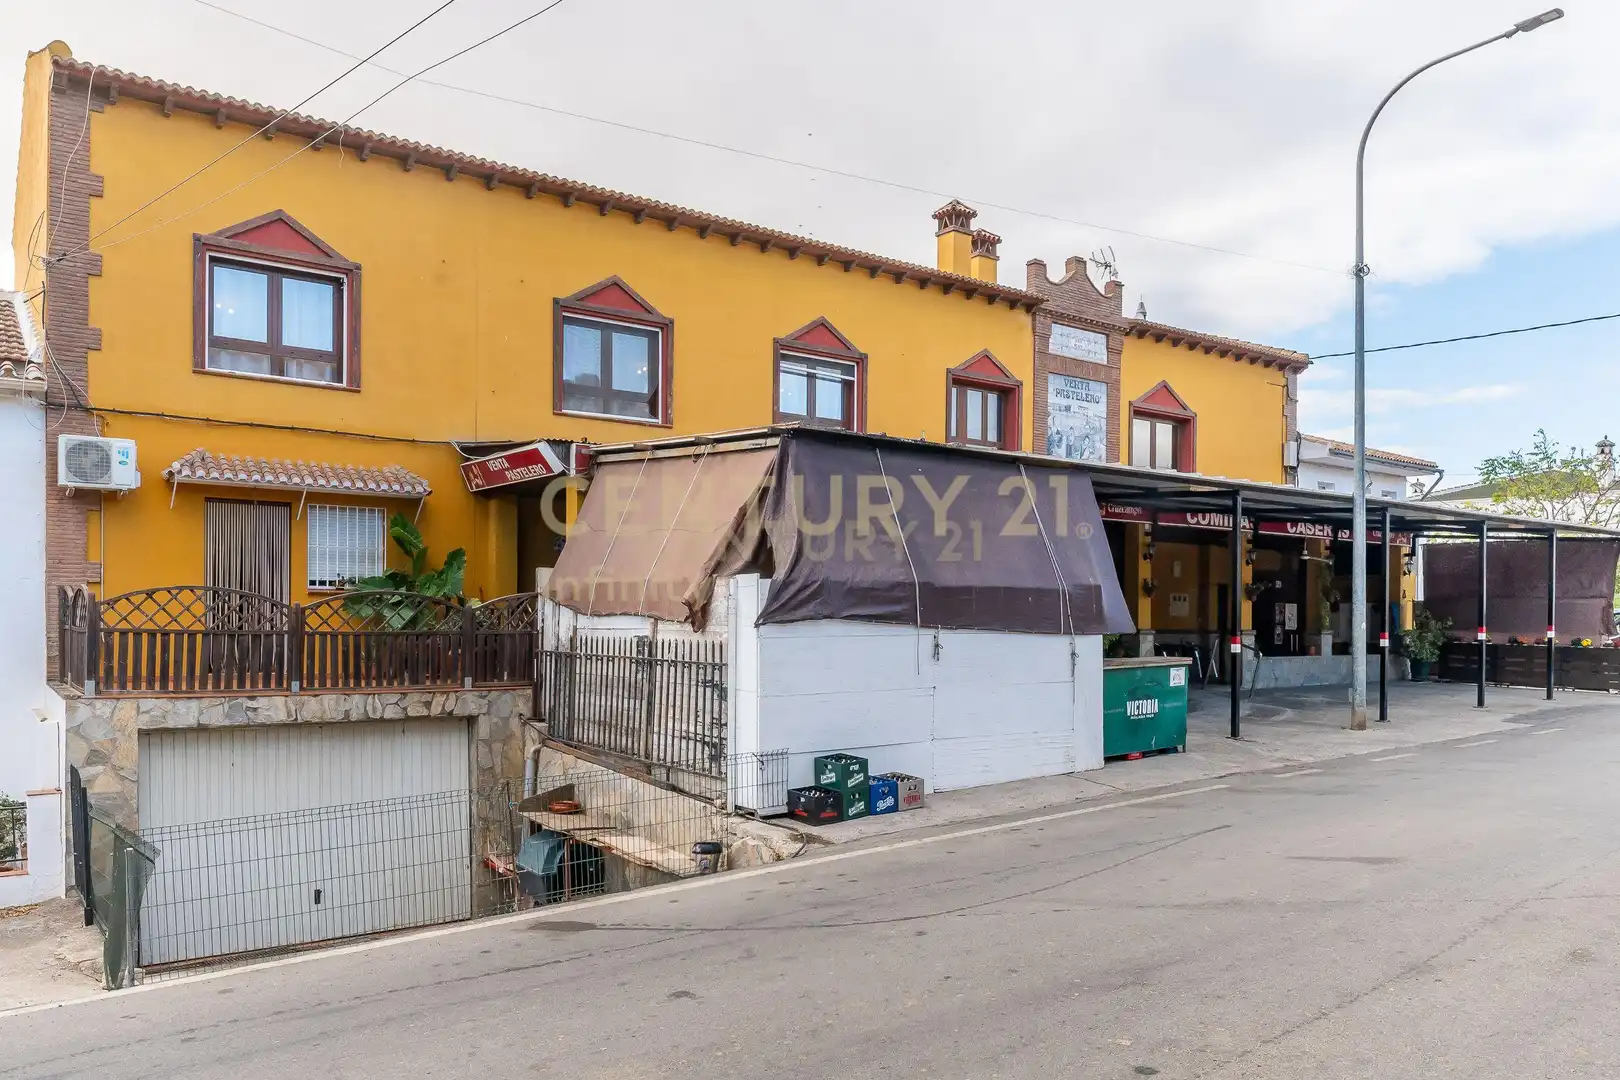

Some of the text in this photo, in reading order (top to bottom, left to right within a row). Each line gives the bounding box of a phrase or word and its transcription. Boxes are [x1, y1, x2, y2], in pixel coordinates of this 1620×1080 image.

[1063, 378, 1090, 391] VENTA
[486, 458, 509, 472] VENTA
[505, 464, 546, 481] PASTELERO
[1126, 699, 1158, 716] VICTORIA
